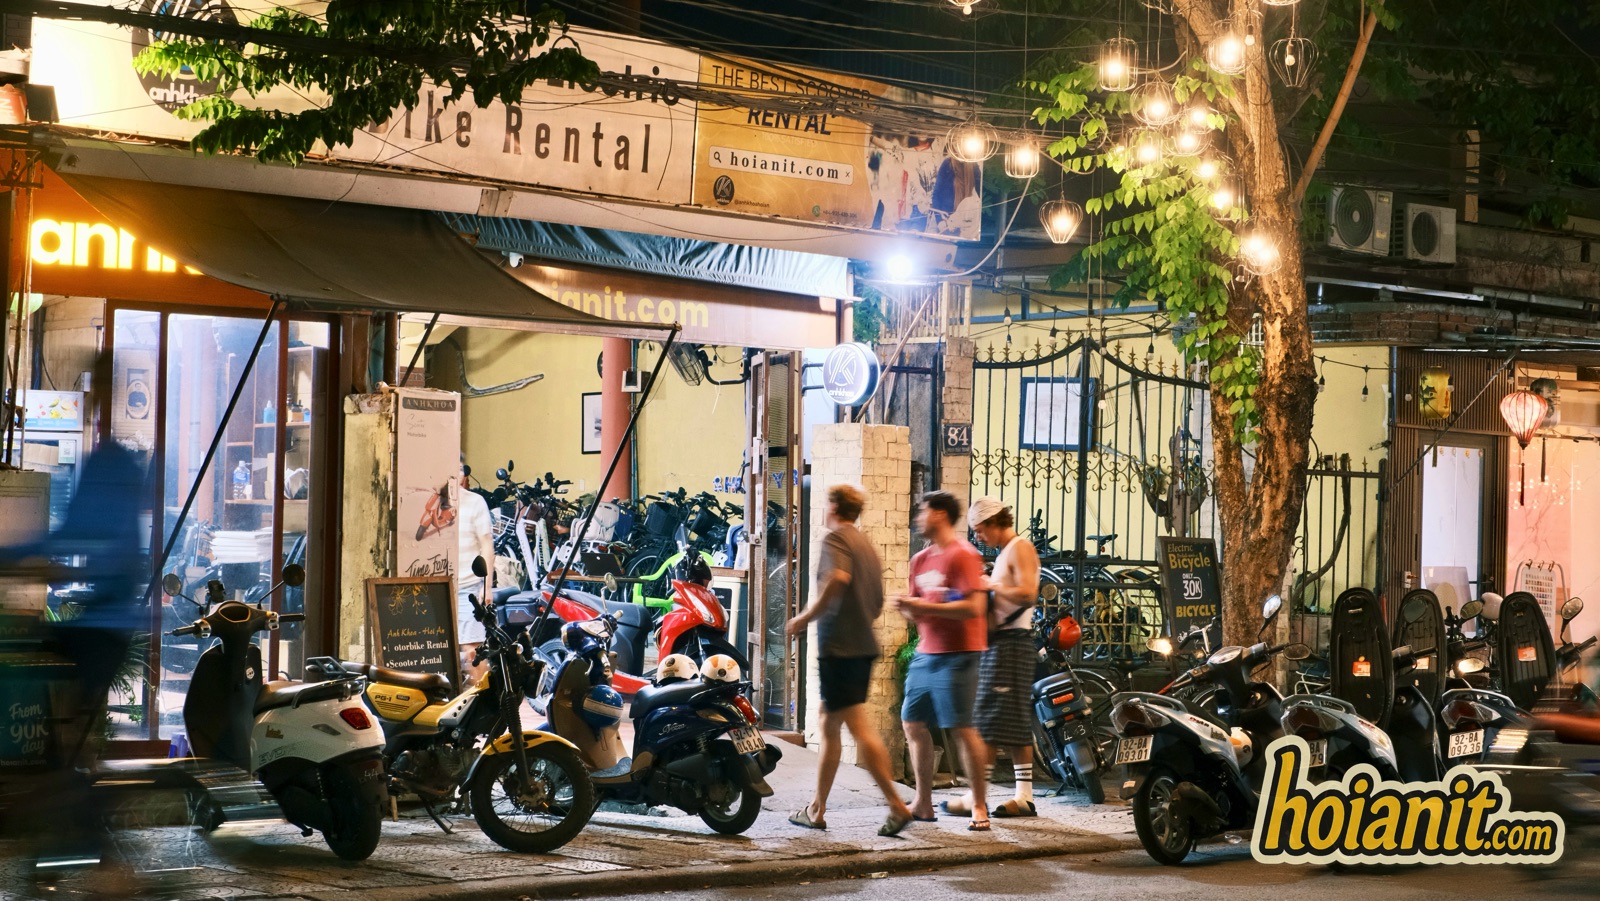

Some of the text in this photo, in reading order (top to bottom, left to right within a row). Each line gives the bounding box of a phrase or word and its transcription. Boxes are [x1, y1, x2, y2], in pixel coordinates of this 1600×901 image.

[712, 65, 745, 88] THE
[750, 71, 788, 93] BEST
[149, 82, 206, 105] anhkh
[747, 108, 832, 135] RENTAL
[369, 89, 651, 173] ike Rental
[730, 151, 839, 180] hoianit.com
[406, 398, 454, 409] ANHKHOA
[947, 426, 969, 447] 84
[1168, 551, 1211, 572] Bicycle
[1183, 580, 1201, 597] 30K
[426, 640, 448, 650] Rental
[375, 694, 391, 702] PG-1
[9, 702, 42, 720] From
[736, 738, 765, 752] 048.40
[1123, 737, 1147, 750] 92-BA
[1454, 731, 1478, 746] 92-BA
[21, 740, 45, 755] day
[1309, 741, 1321, 753] BA
[1450, 742, 1481, 757] 092.36
[1119, 749, 1149, 762] 093.01
